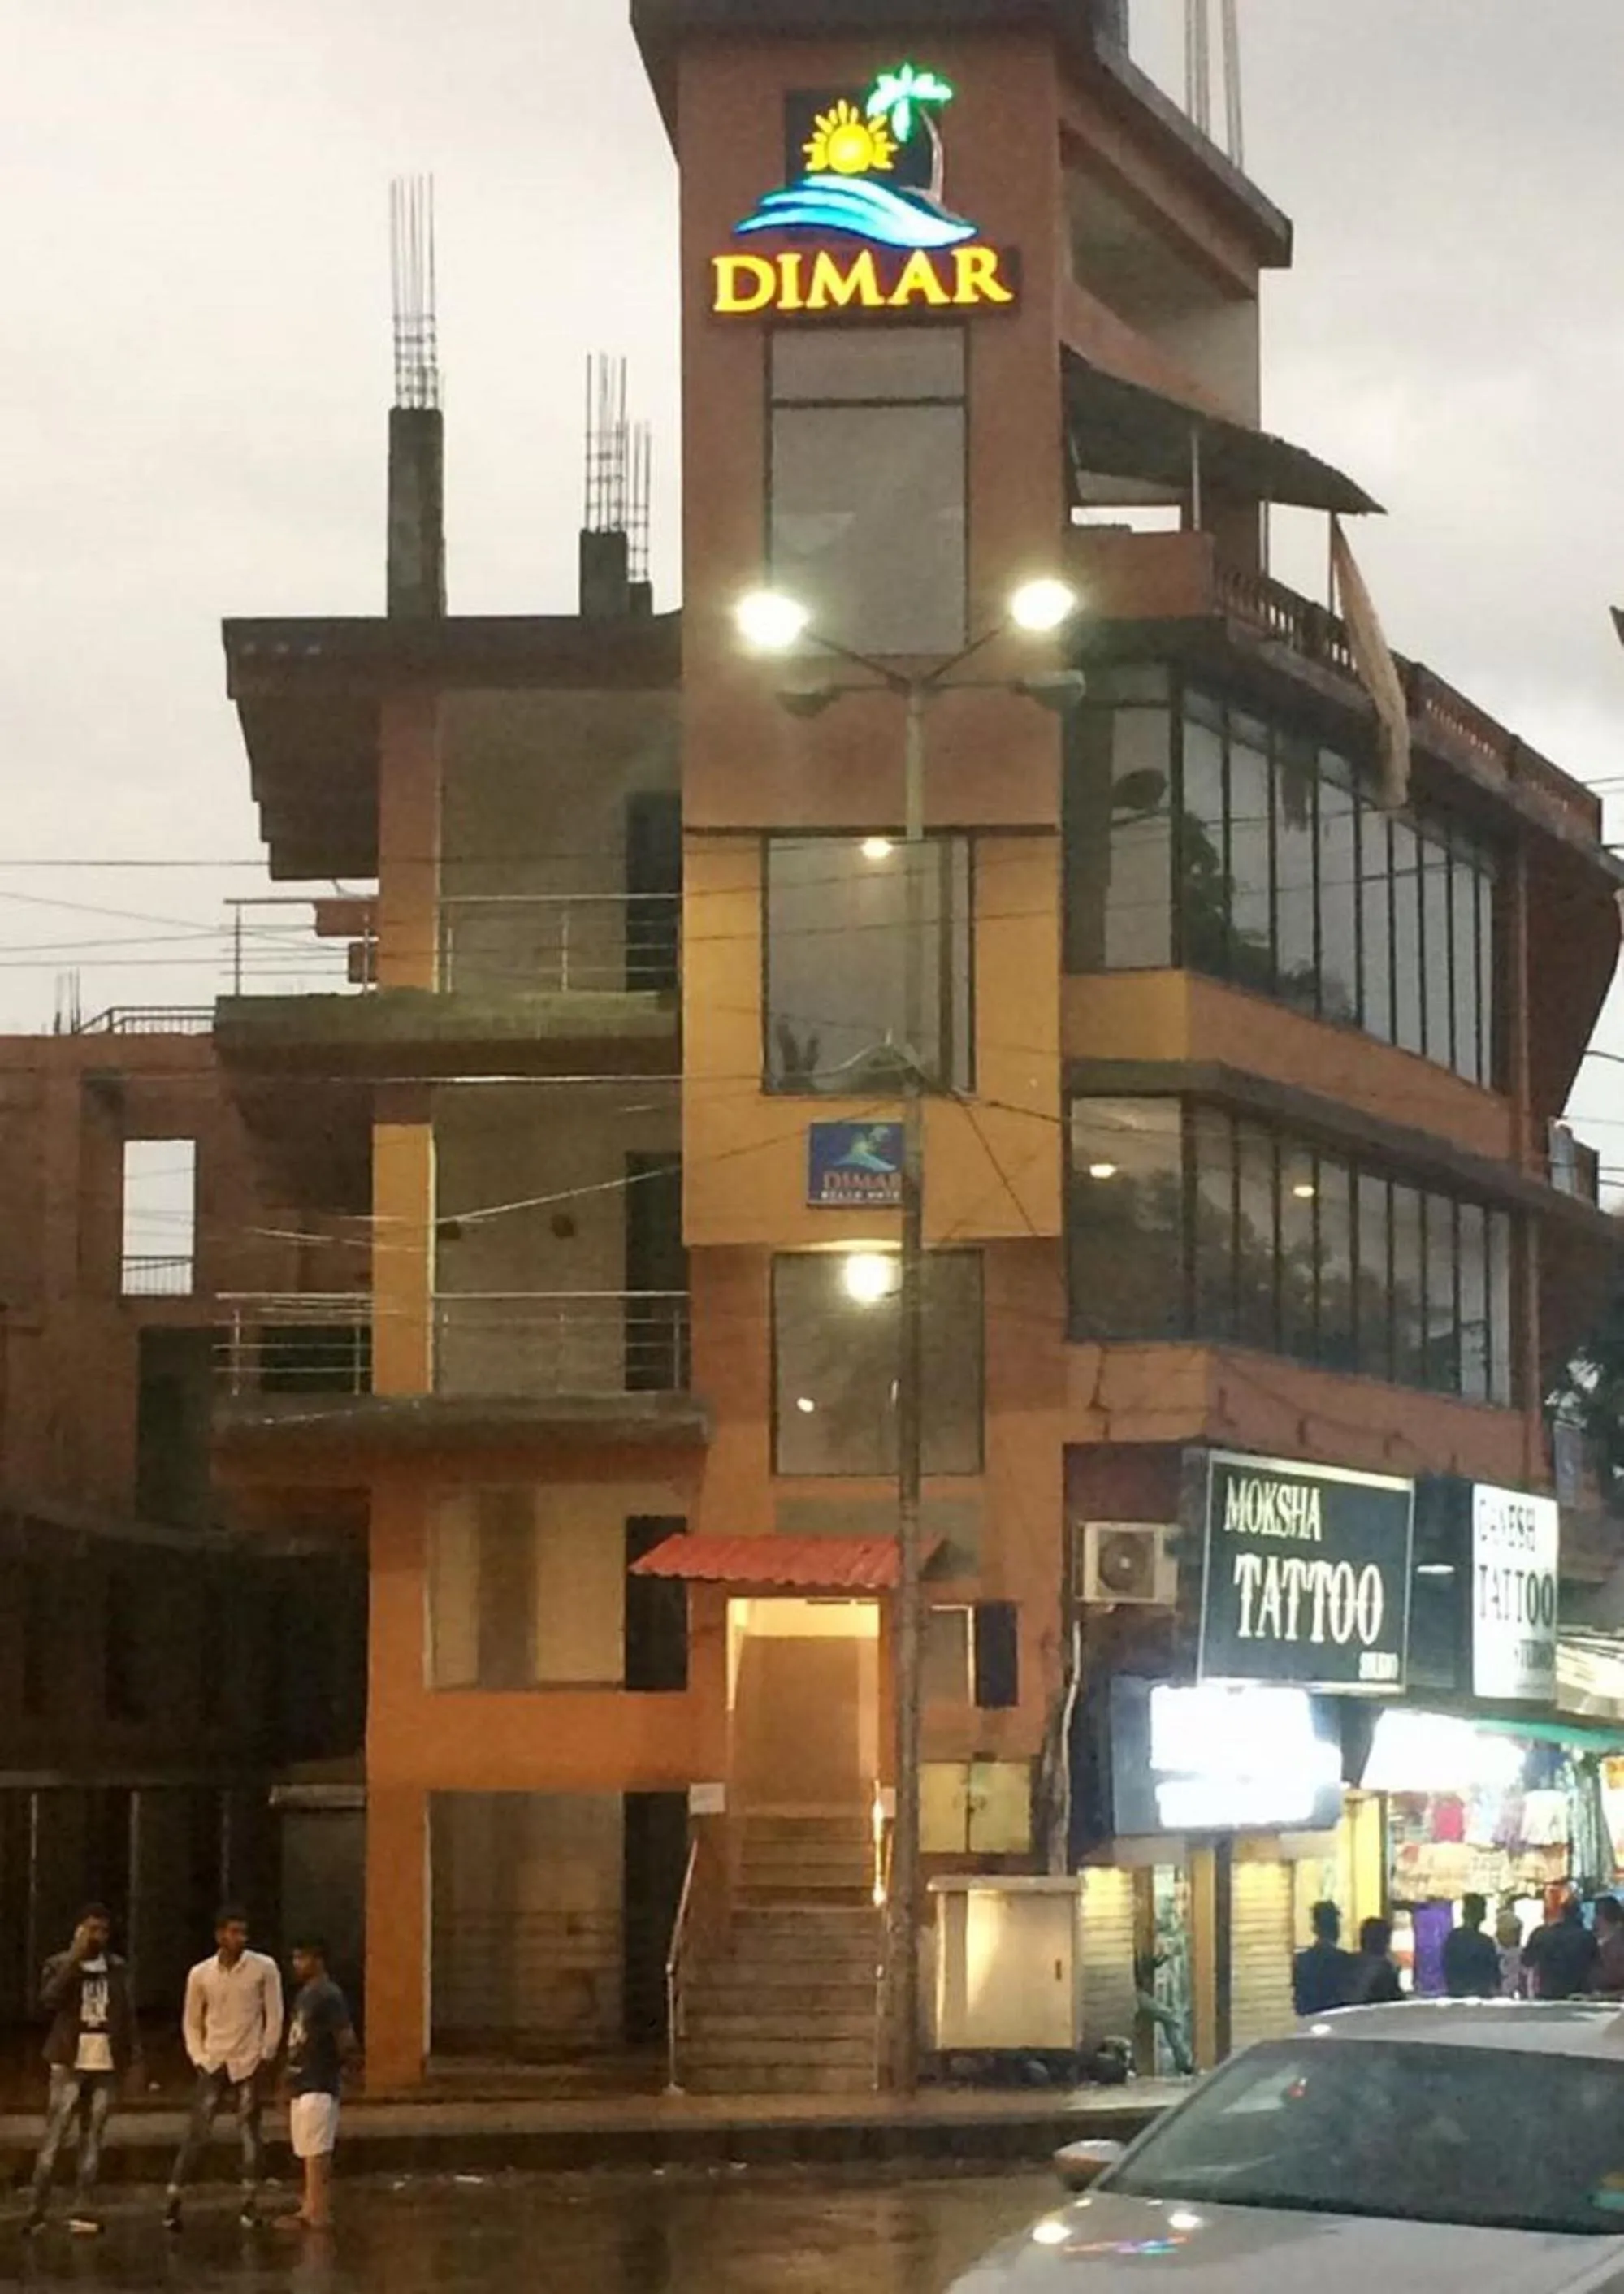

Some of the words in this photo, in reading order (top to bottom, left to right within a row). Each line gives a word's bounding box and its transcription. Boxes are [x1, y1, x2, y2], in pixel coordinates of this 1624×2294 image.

[712, 246, 1014, 312] DIMAR
[1223, 1477, 1322, 1542] MOKSHA
[1233, 1553, 1384, 1645] TATTOO
[1479, 1564, 1555, 1628] TATTOO
